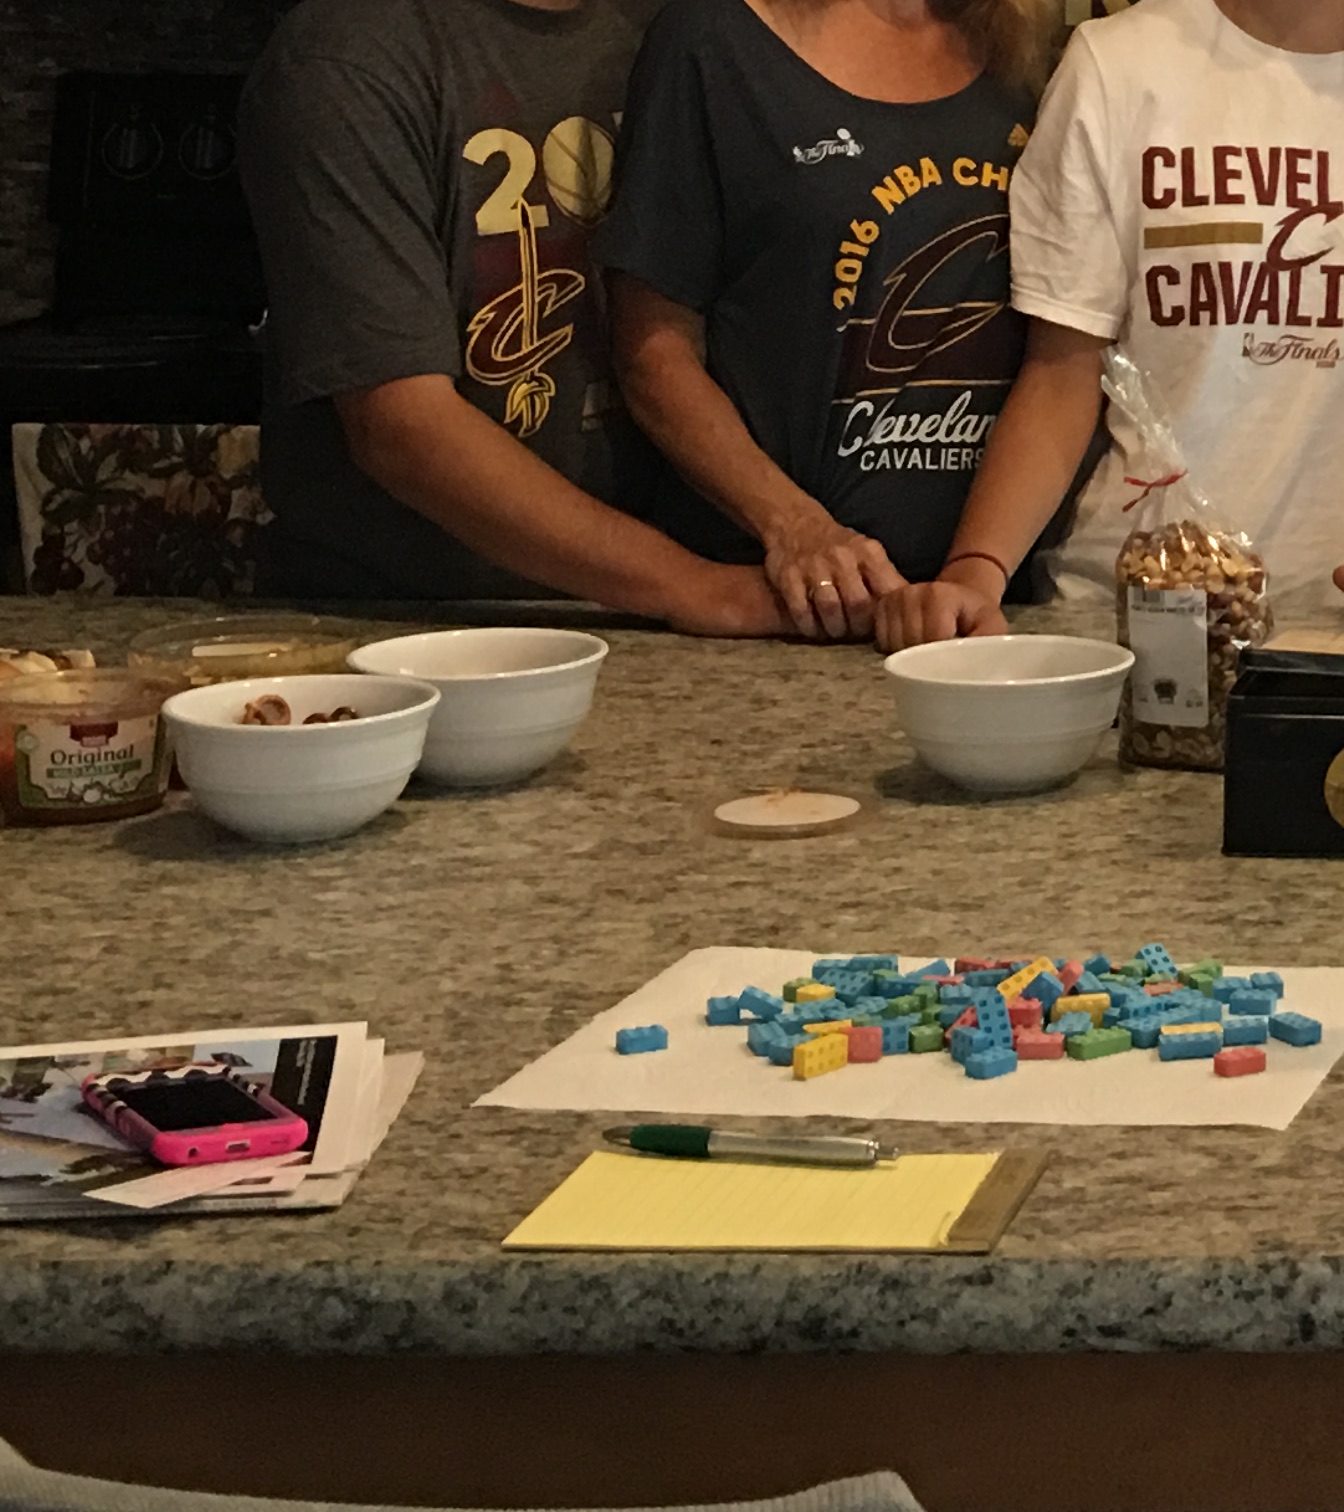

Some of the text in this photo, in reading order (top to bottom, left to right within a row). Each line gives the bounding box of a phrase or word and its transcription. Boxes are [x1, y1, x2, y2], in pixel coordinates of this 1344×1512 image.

[833, 219, 880, 310] 2016
[871, 156, 942, 215] NBA
[1277, 334, 1341, 362] Finals
[837, 389, 998, 458] Clevelan
[50, 744, 134, 766] Original
